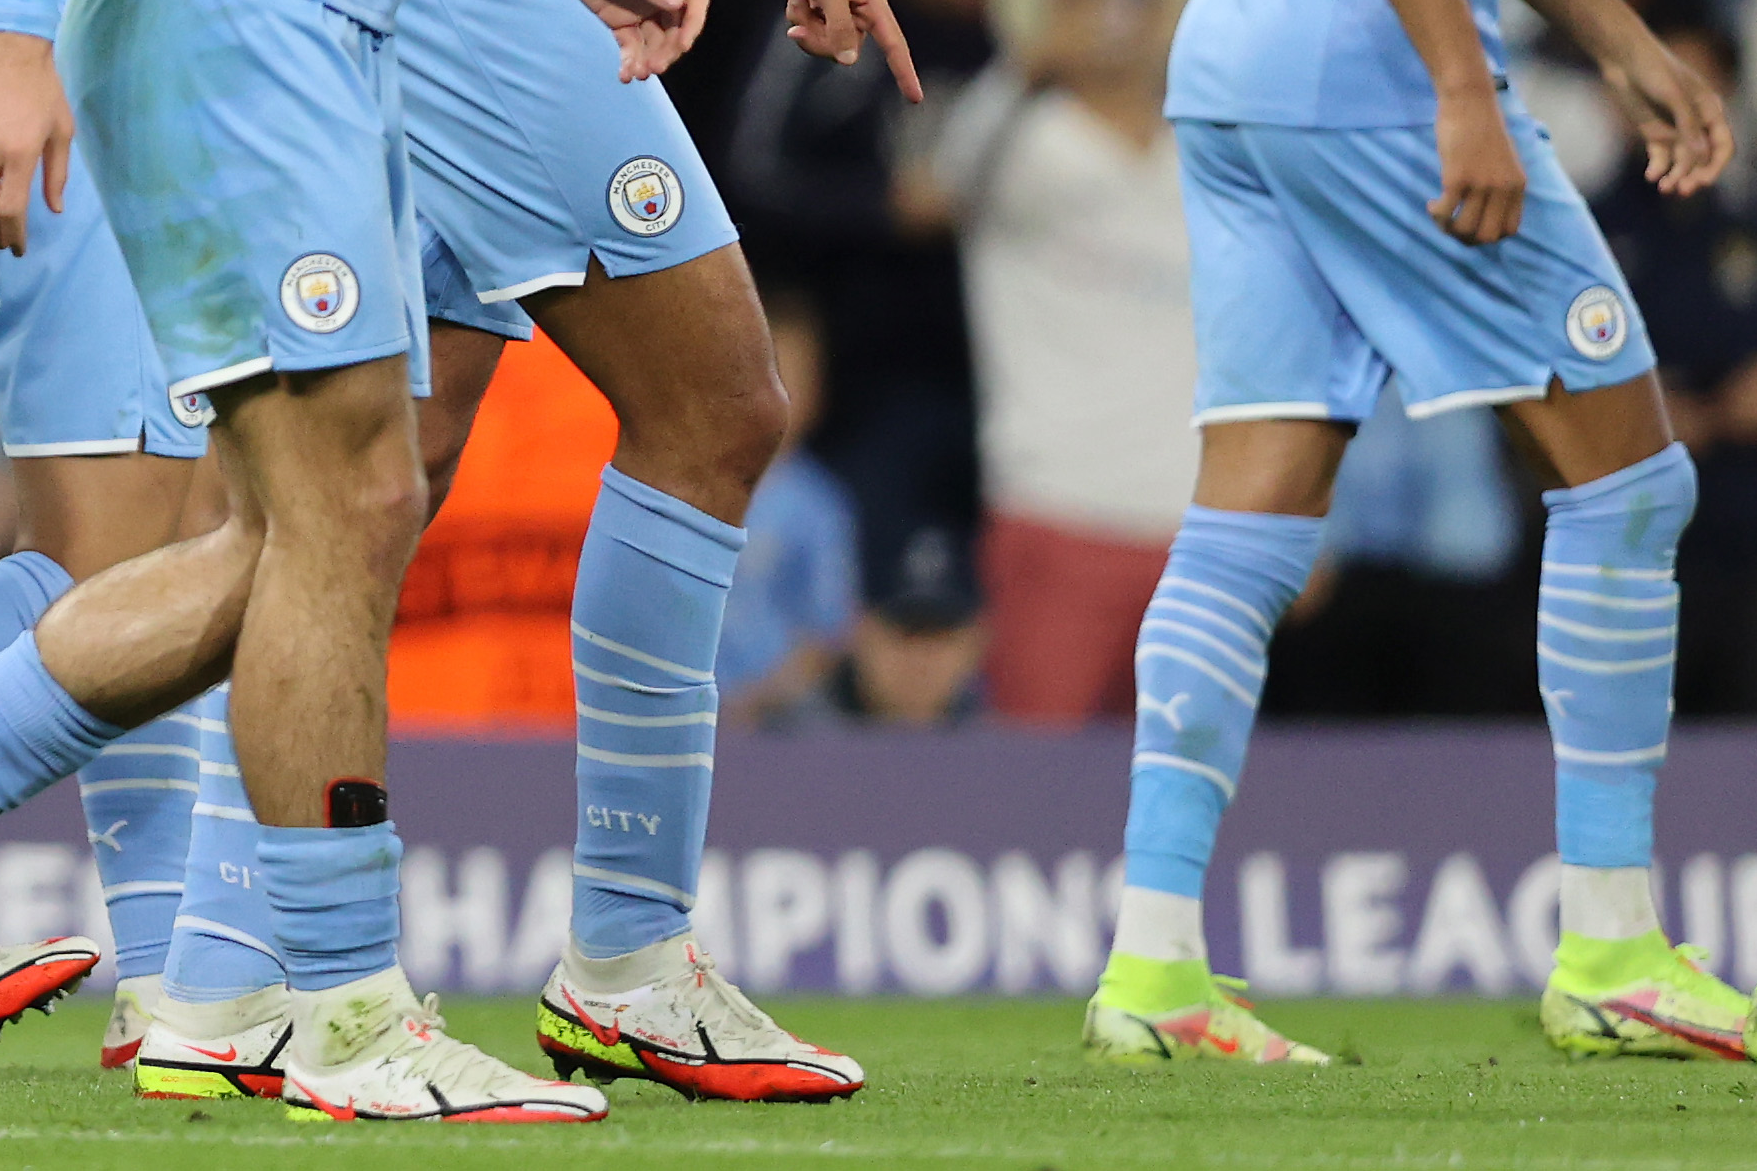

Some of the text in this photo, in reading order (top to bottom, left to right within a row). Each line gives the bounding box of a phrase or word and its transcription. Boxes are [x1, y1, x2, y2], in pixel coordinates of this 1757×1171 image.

[613, 161, 670, 195] MANCHESTER
[645, 220, 667, 232] CITY
[587, 805, 661, 836] CITY
